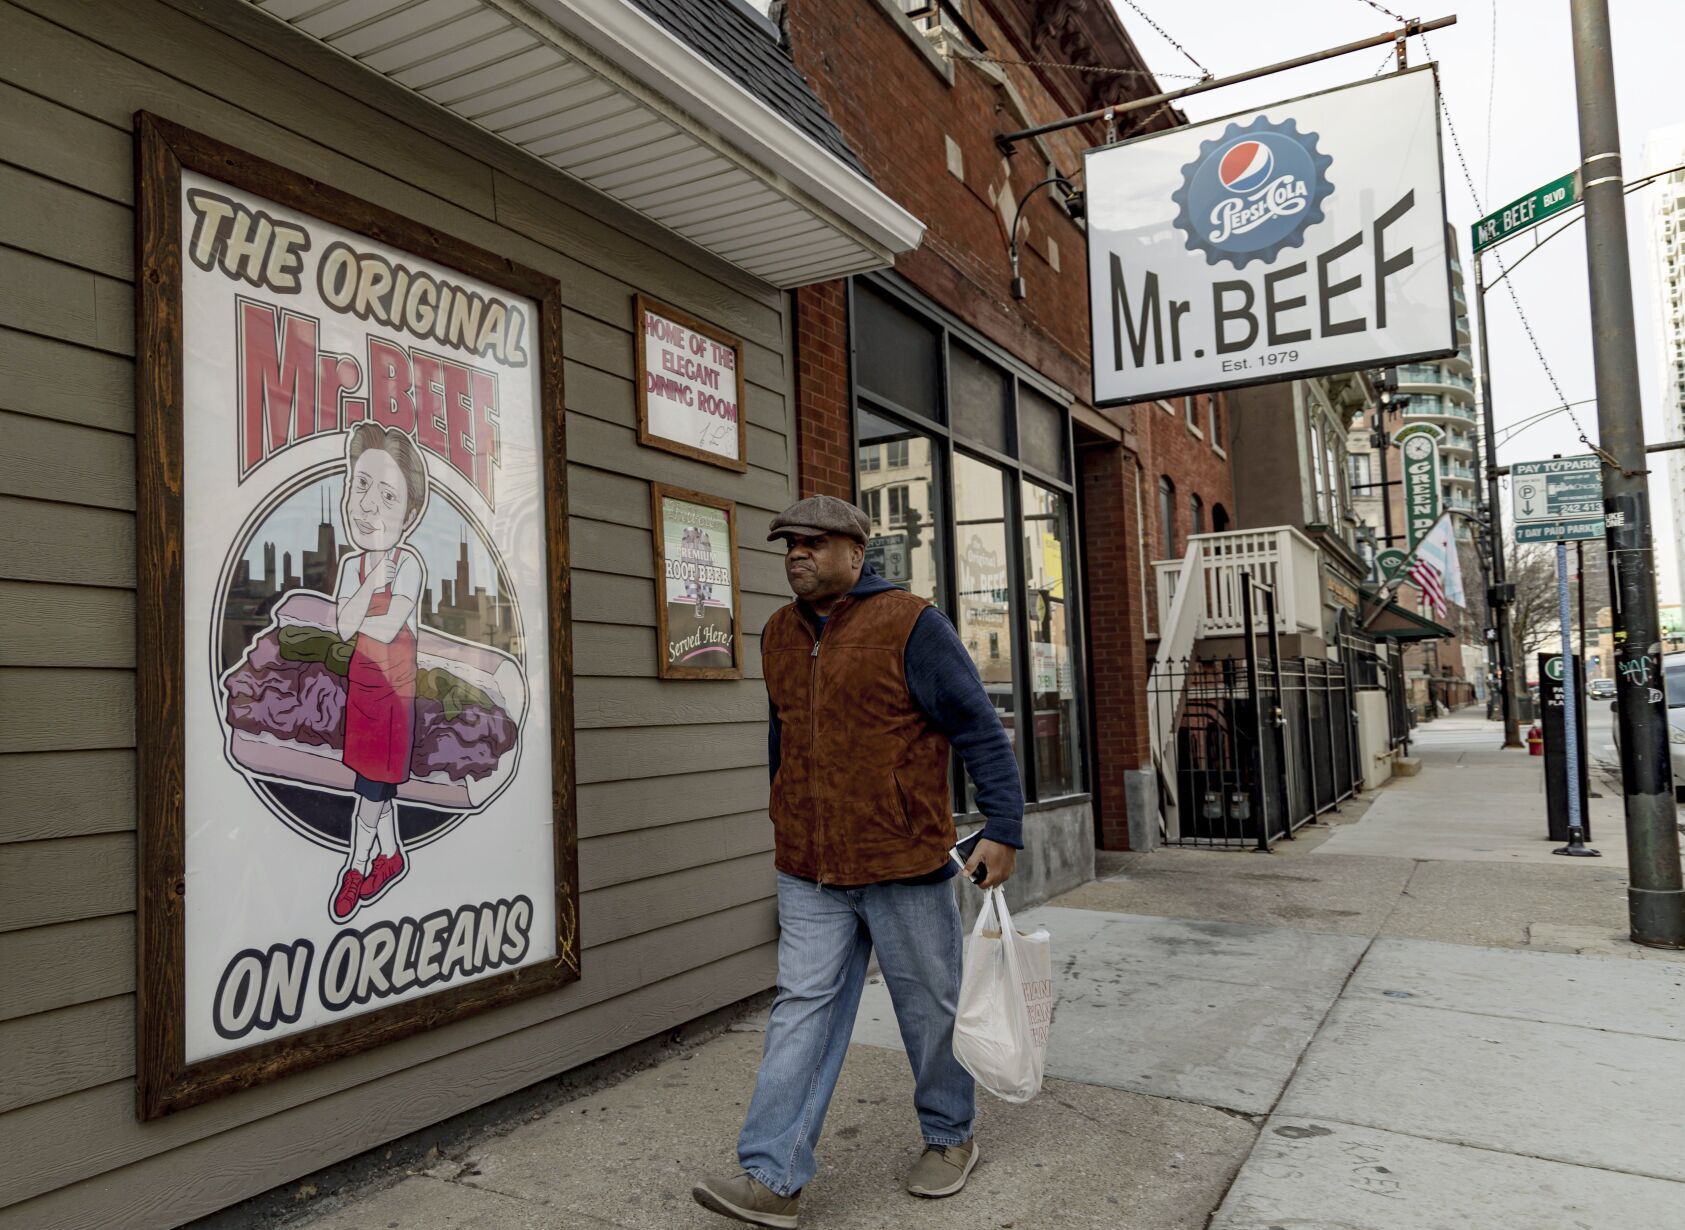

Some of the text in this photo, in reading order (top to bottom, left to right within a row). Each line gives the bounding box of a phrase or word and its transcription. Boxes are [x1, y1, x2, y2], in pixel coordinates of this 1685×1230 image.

[1477, 187, 1566, 244] MR. BEEF BLVD
[187, 187, 528, 368] THE ORIGINAL
[1109, 188, 1415, 371] Mr. BEEF
[645, 314, 734, 371] HOME OF THE
[1221, 350, 1299, 373] Est. 1979
[235, 293, 502, 512] Mr. BEEF
[646, 371, 737, 423] DINING ROOM
[1408, 461, 1432, 515] GREEN
[1516, 460, 1599, 474] PAY TO PARK
[1517, 524, 1592, 538] 7 DAY PAID PARK
[1561, 504, 1581, 513] 242
[665, 559, 731, 586] ROOT BEER
[668, 623, 733, 662] Served Here!
[213, 894, 533, 1040] ON ORLEANS
